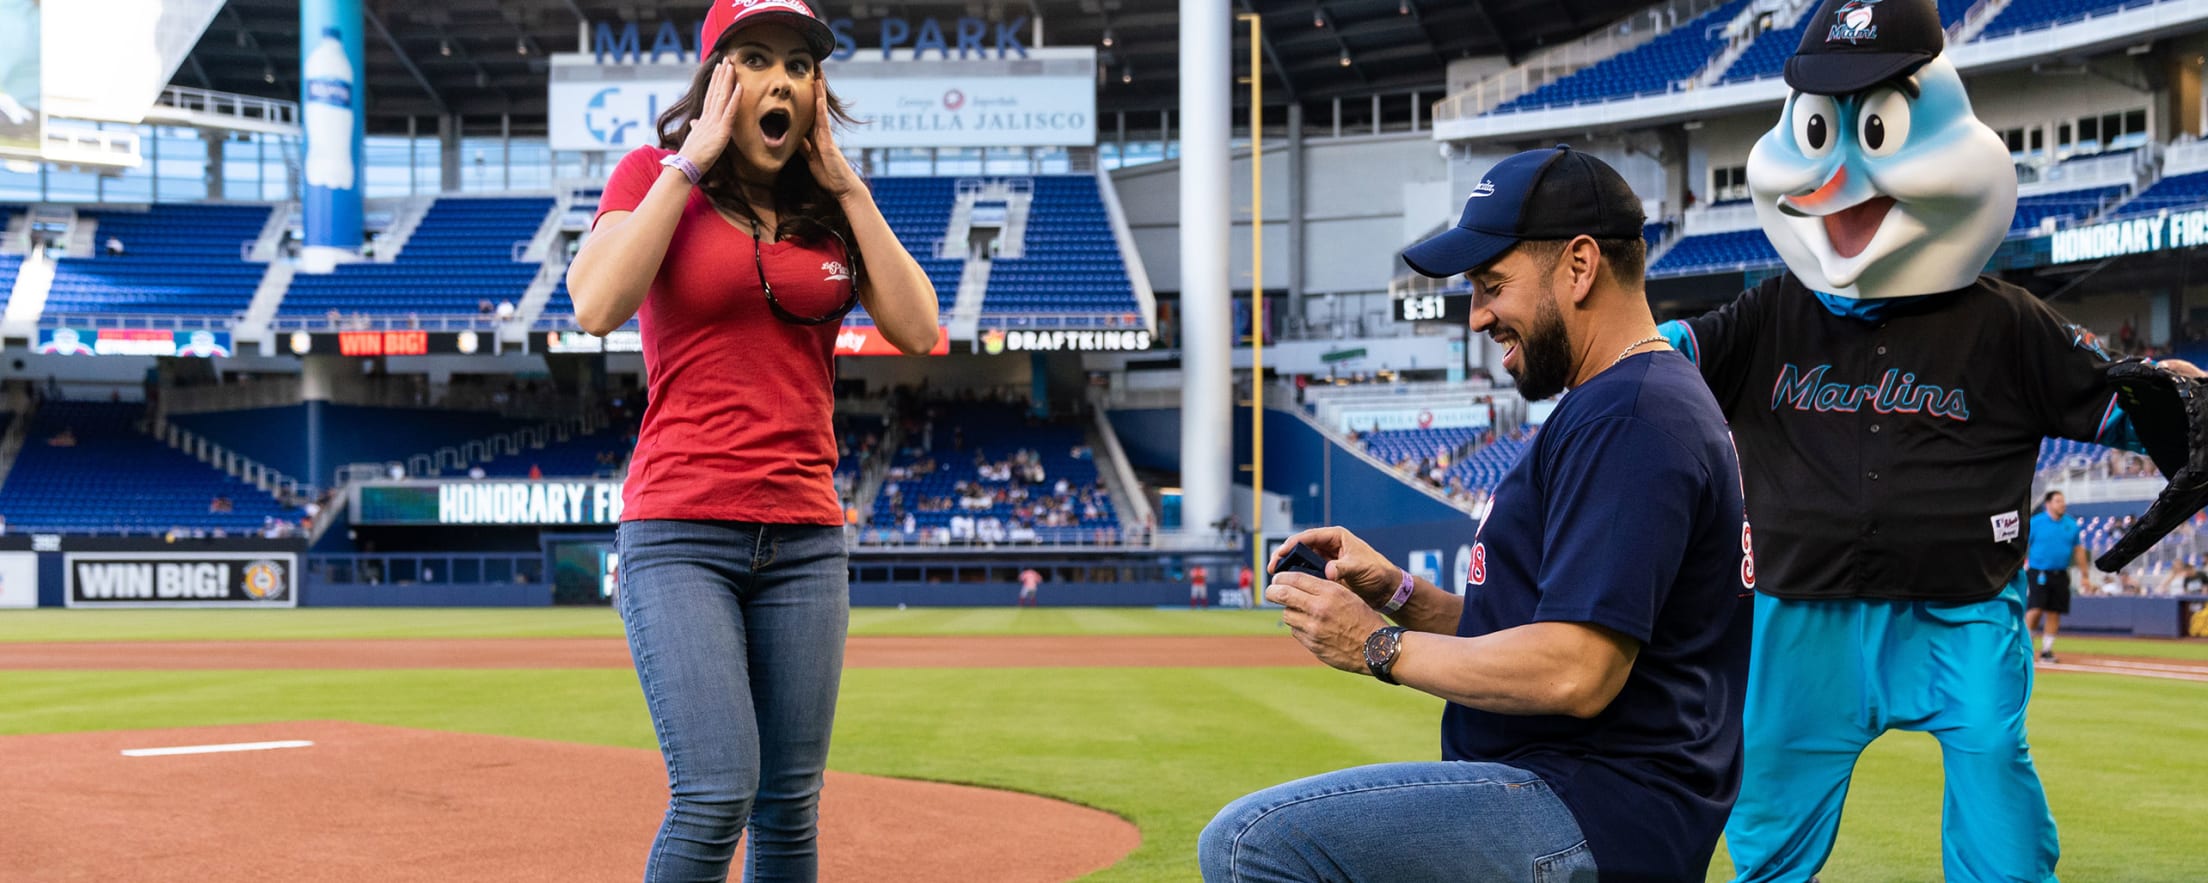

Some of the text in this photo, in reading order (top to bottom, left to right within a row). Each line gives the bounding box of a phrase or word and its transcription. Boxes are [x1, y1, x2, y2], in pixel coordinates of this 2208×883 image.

[879, 16, 1029, 60] PARK
[1825, 24, 1877, 45] Miami
[972, 112, 1086, 130] JALISCO
[2051, 215, 2166, 264] HONORARY
[1403, 295, 1446, 320] 5:51
[339, 331, 428, 355] WIN BIG!
[1007, 331, 1150, 351] DRAFTKINGS
[1771, 363, 1970, 421] Marlins
[438, 483, 586, 524] HONORARY
[78, 563, 153, 598] WIN
[156, 563, 230, 598] BIG!
